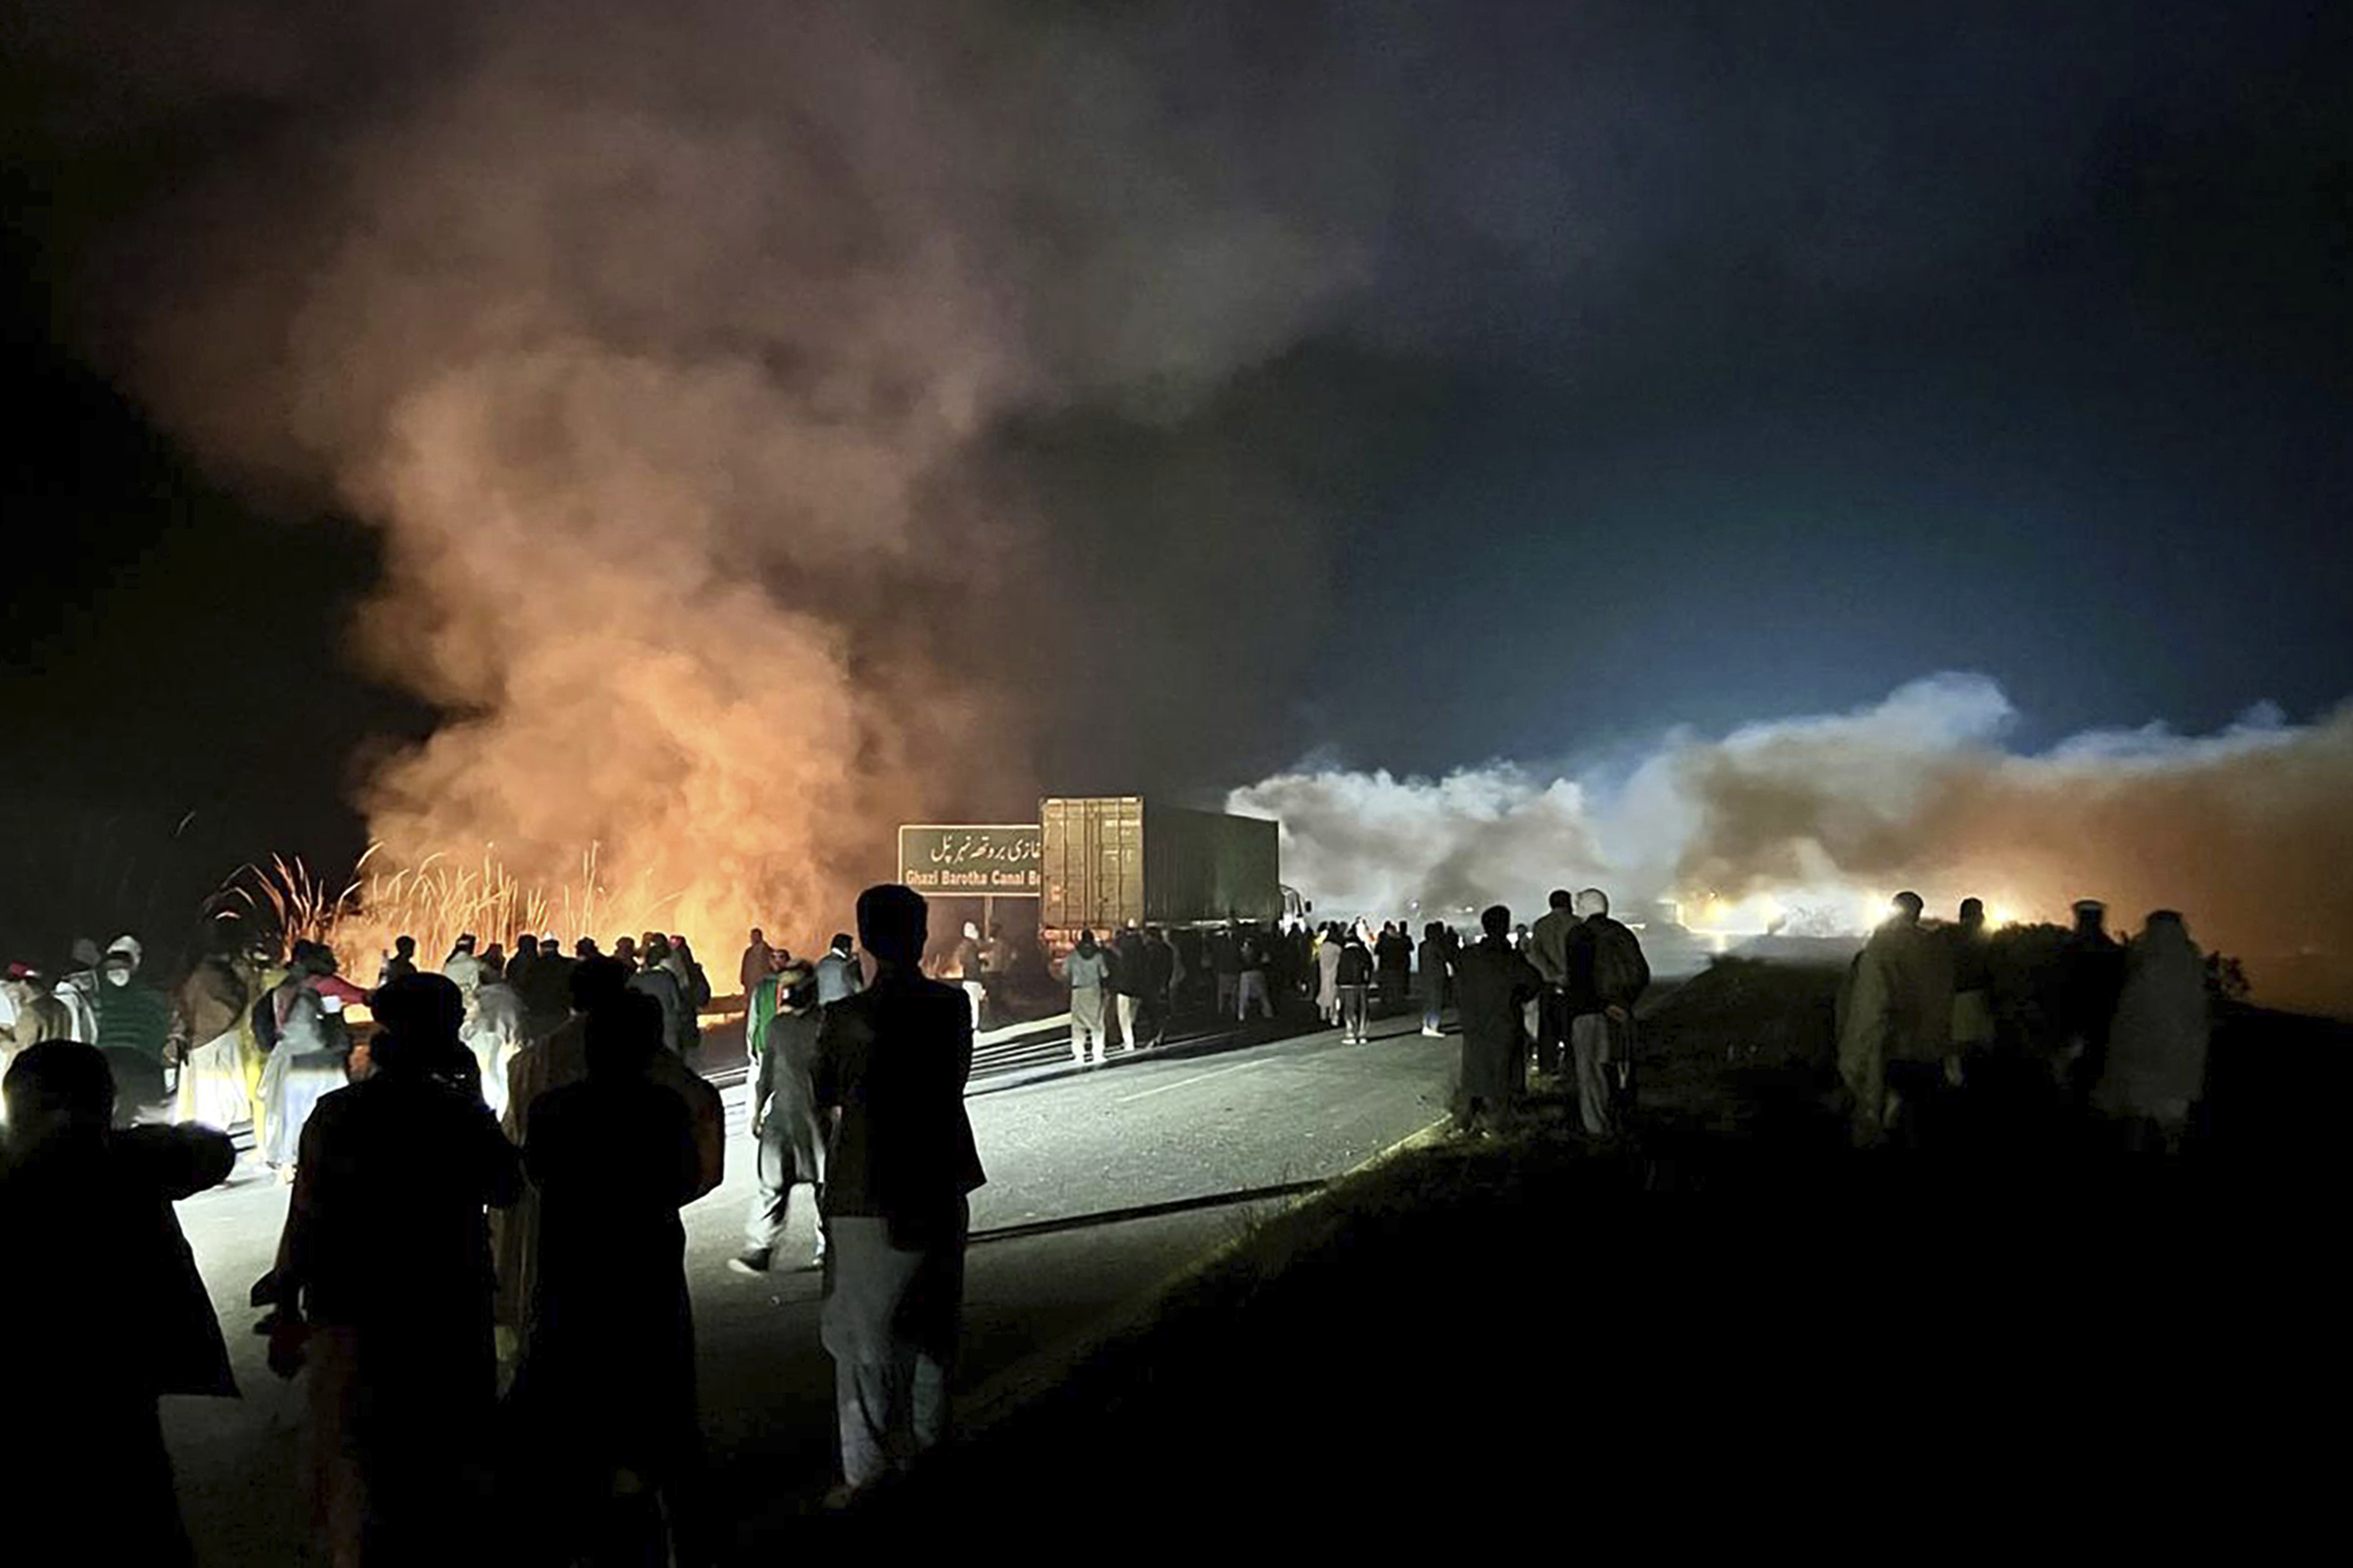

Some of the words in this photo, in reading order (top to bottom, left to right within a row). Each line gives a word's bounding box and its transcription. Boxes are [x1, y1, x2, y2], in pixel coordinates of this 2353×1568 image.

[906, 870, 938, 885] Ghazi
[941, 870, 987, 885] Barotha
[991, 870, 1024, 885] Canal
